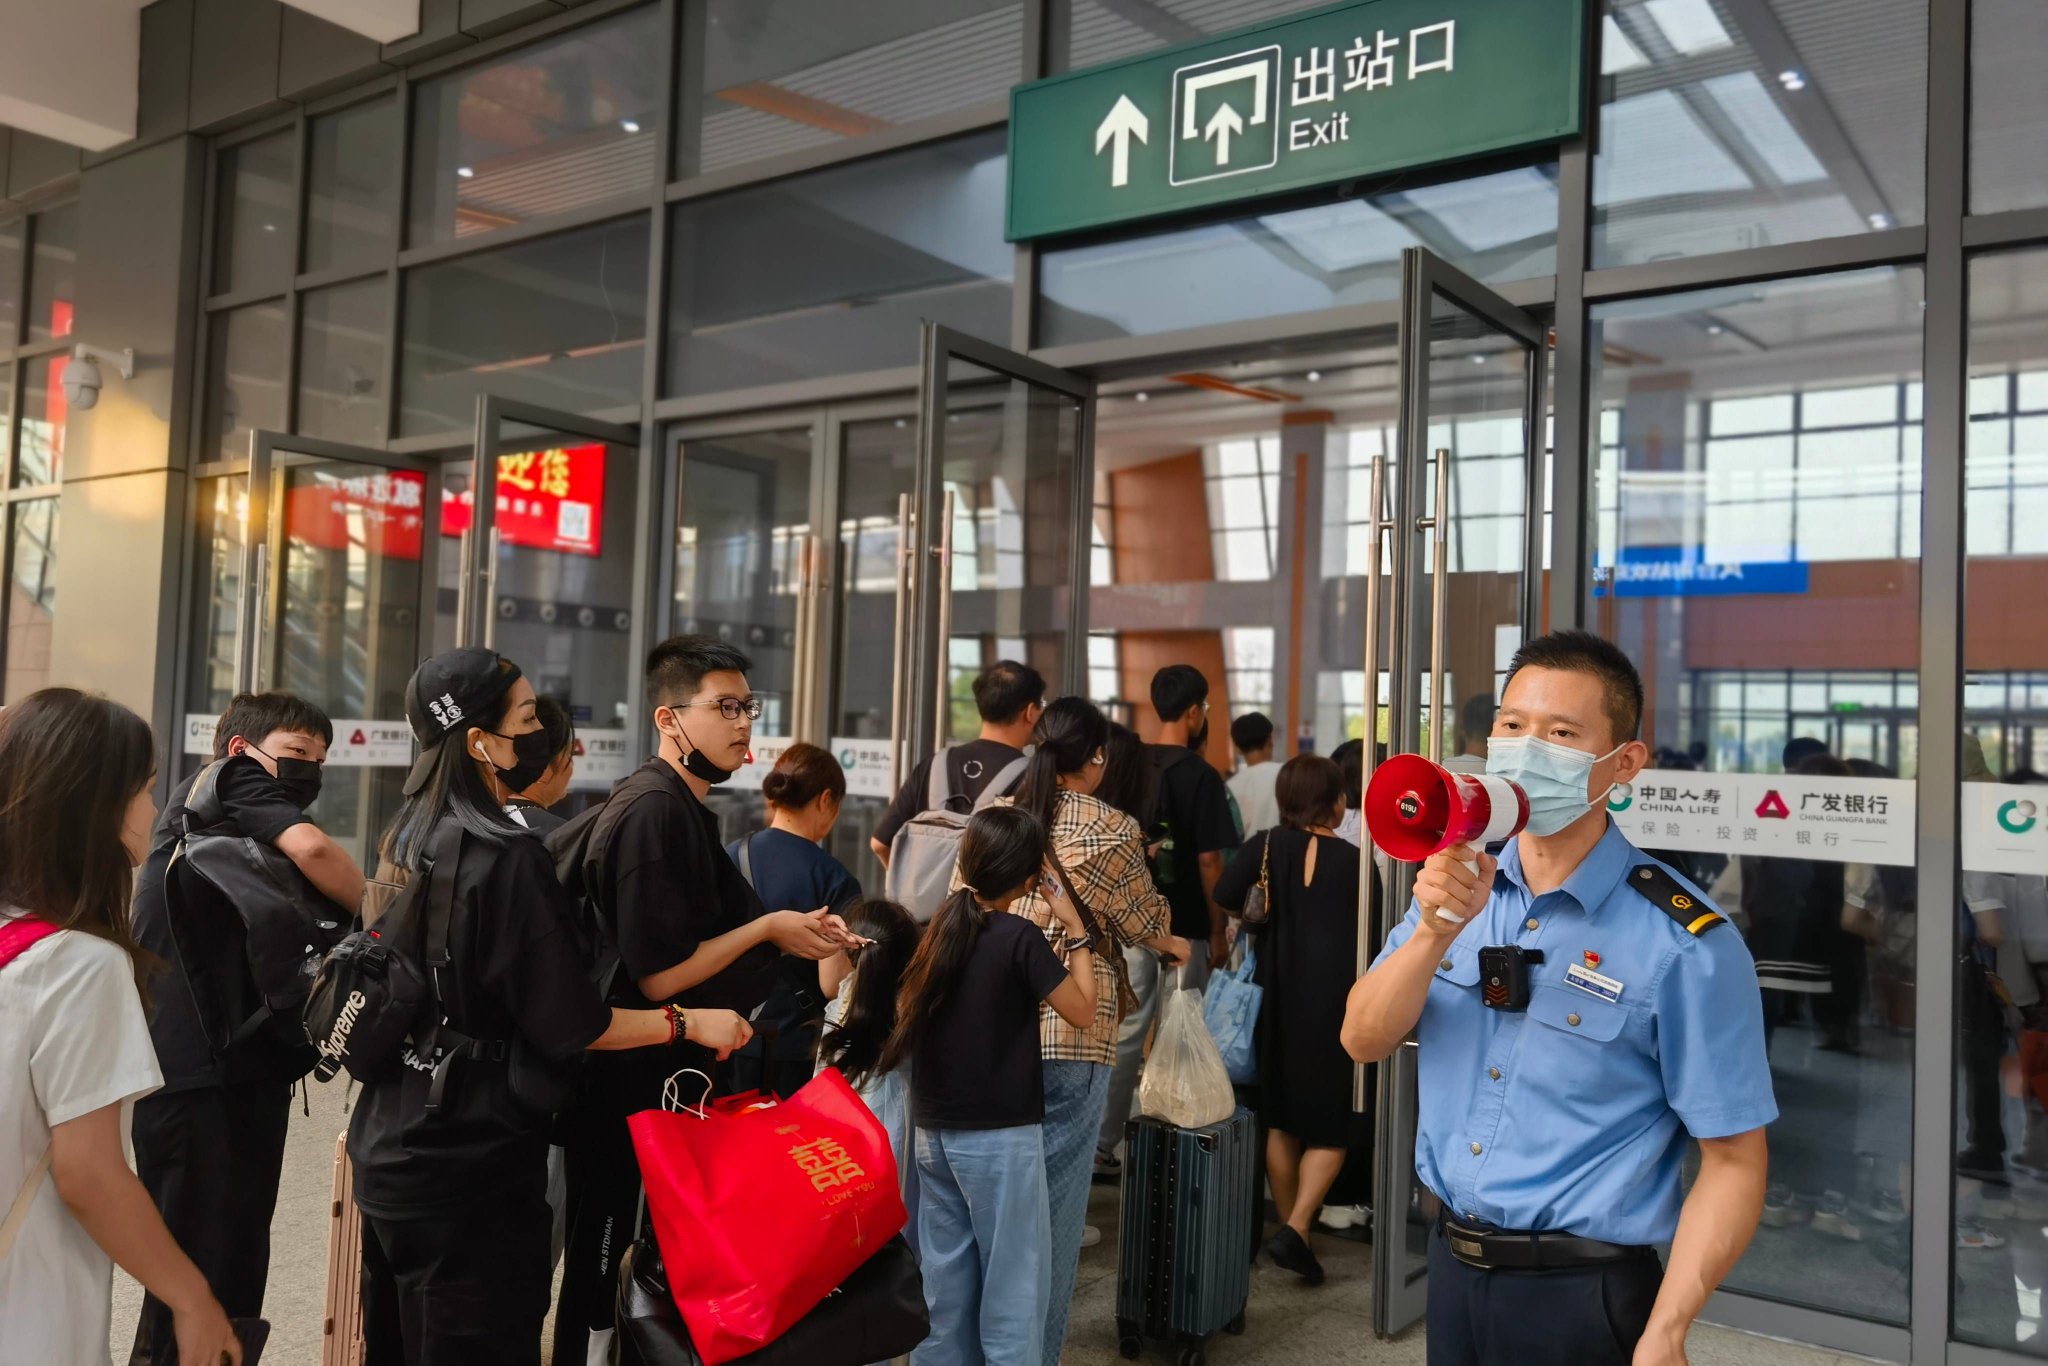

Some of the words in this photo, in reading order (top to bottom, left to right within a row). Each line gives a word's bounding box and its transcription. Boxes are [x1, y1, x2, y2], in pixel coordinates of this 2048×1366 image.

[1291, 19, 1455, 107] 出站口
[1289, 111, 1349, 151] Exit
[1640, 785, 1721, 804] 中国人寿
[1800, 792, 1889, 815] 广发银行
[1640, 803, 1684, 813] CHINA
[1689, 805, 1720, 815] LIFE
[1799, 813, 1824, 822] CHINA
[1825, 814, 1864, 824] GUANGFA
[1865, 817, 1889, 825] BANK
[320, 990, 366, 1062] Supreme
[825, 1189, 853, 1206] LOVE
